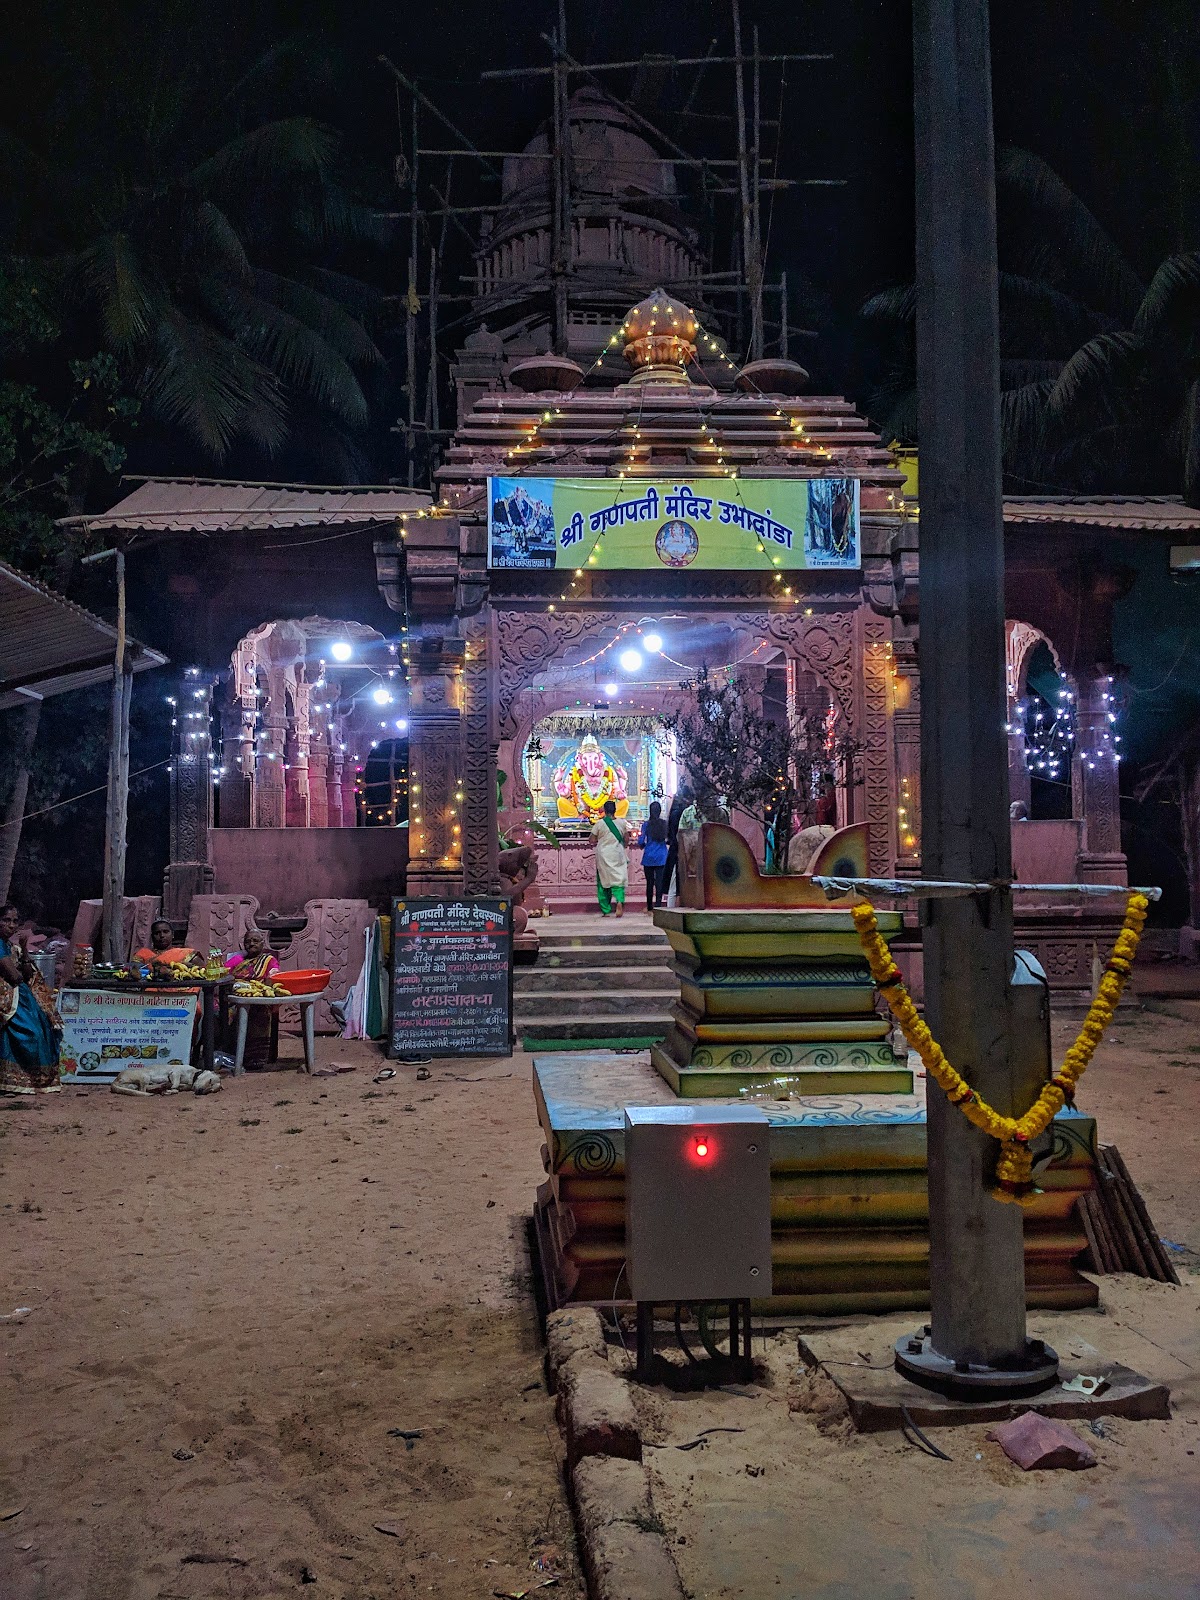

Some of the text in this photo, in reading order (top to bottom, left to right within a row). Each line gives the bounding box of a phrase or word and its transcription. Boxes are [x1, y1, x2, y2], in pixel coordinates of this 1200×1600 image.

[560, 486, 793, 550] श्री गणपती मंदिर उभादांडा
[401, 903, 504, 926] श्री गणपती मंदिर देवस्थान
[94, 995, 103, 1005] श्री
[105, 995, 115, 1005] देव
[118, 995, 145, 1006] गणपती
[147, 996, 170, 1007] महिला
